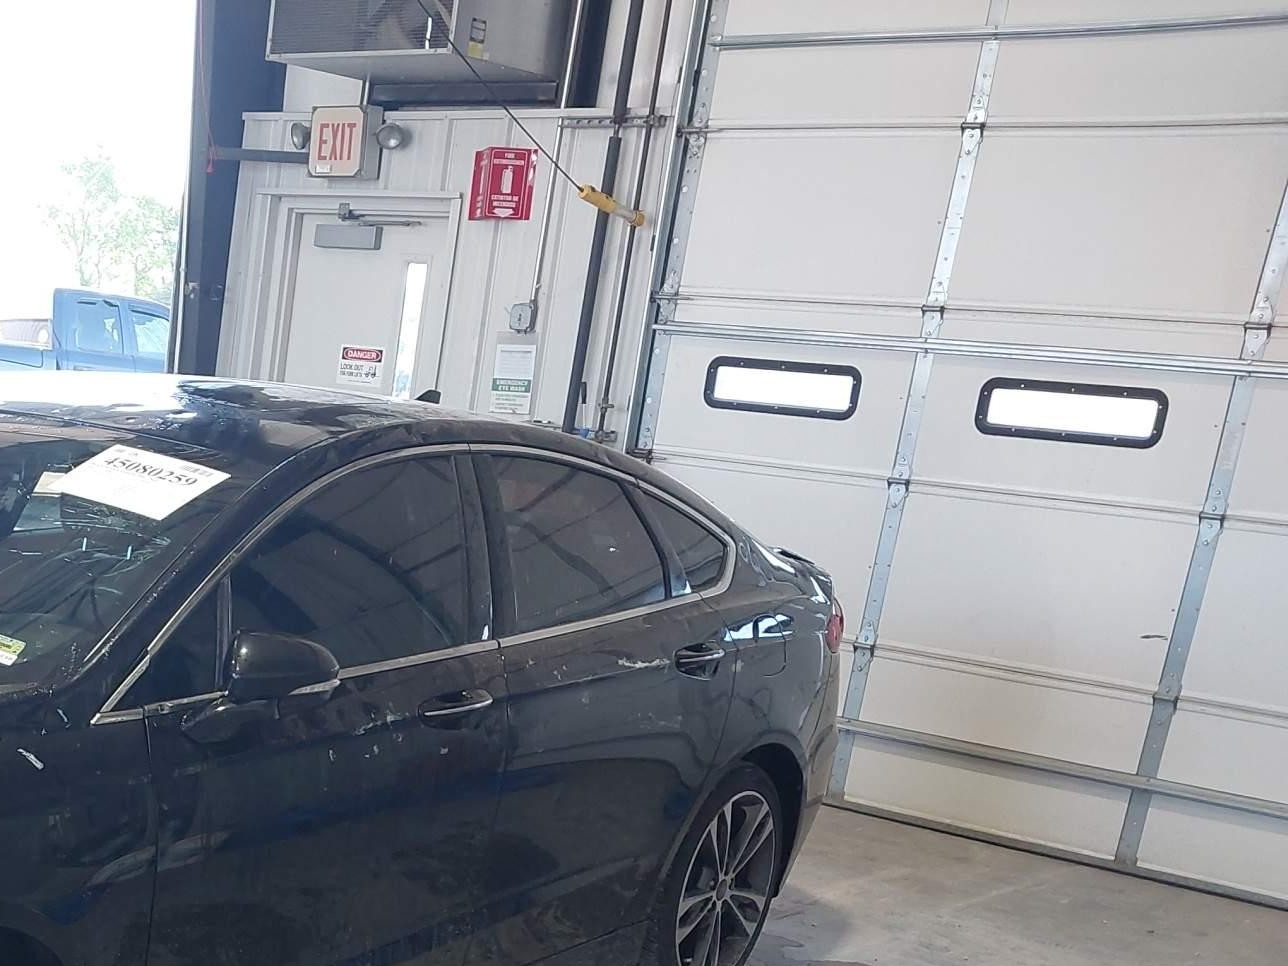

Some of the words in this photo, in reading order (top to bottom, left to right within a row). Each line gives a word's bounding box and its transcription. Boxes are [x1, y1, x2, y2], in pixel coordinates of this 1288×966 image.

[317, 123, 357, 161] EXIT
[347, 350, 377, 360] DANGER
[103, 457, 198, 486] 45080259
